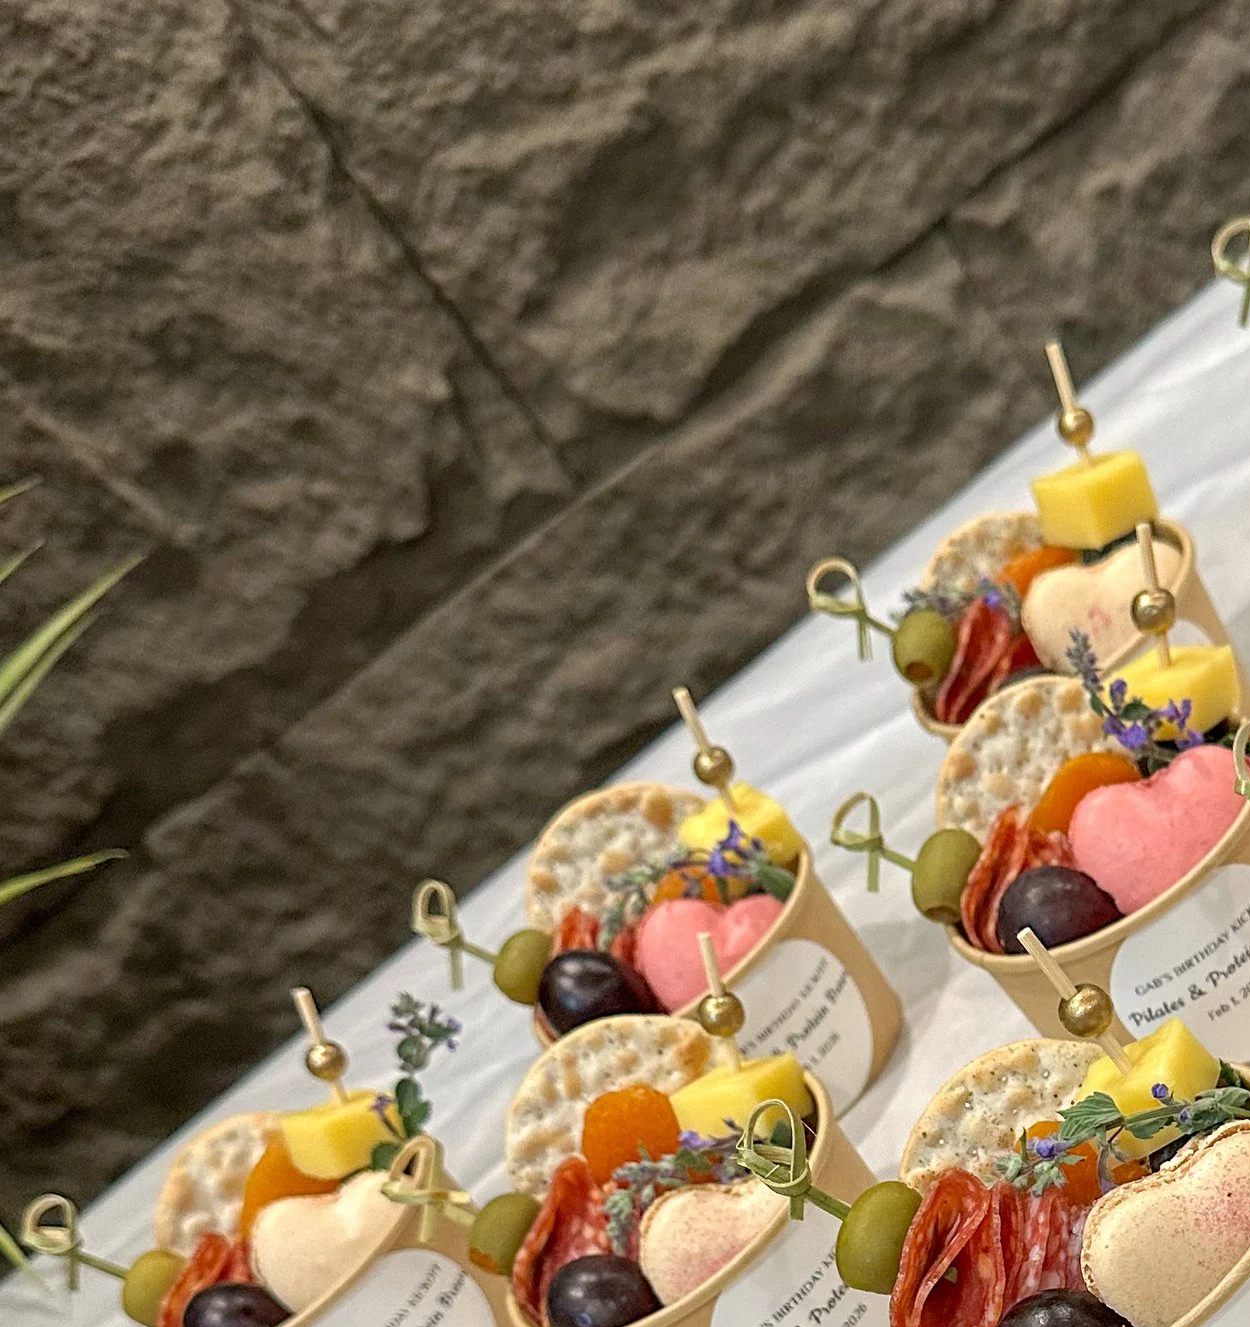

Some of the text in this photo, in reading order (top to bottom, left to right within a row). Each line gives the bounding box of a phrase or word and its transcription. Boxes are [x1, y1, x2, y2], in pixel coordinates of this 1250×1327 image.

[1135, 972, 1174, 997] GAB'S
[1172, 932, 1231, 977] BIRTHDAY
[1129, 998, 1186, 1027] Pilates
[1188, 983, 1208, 1002] &
[772, 1268, 824, 1323] BIRTHDAY
[809, 1283, 850, 1325] Prote
